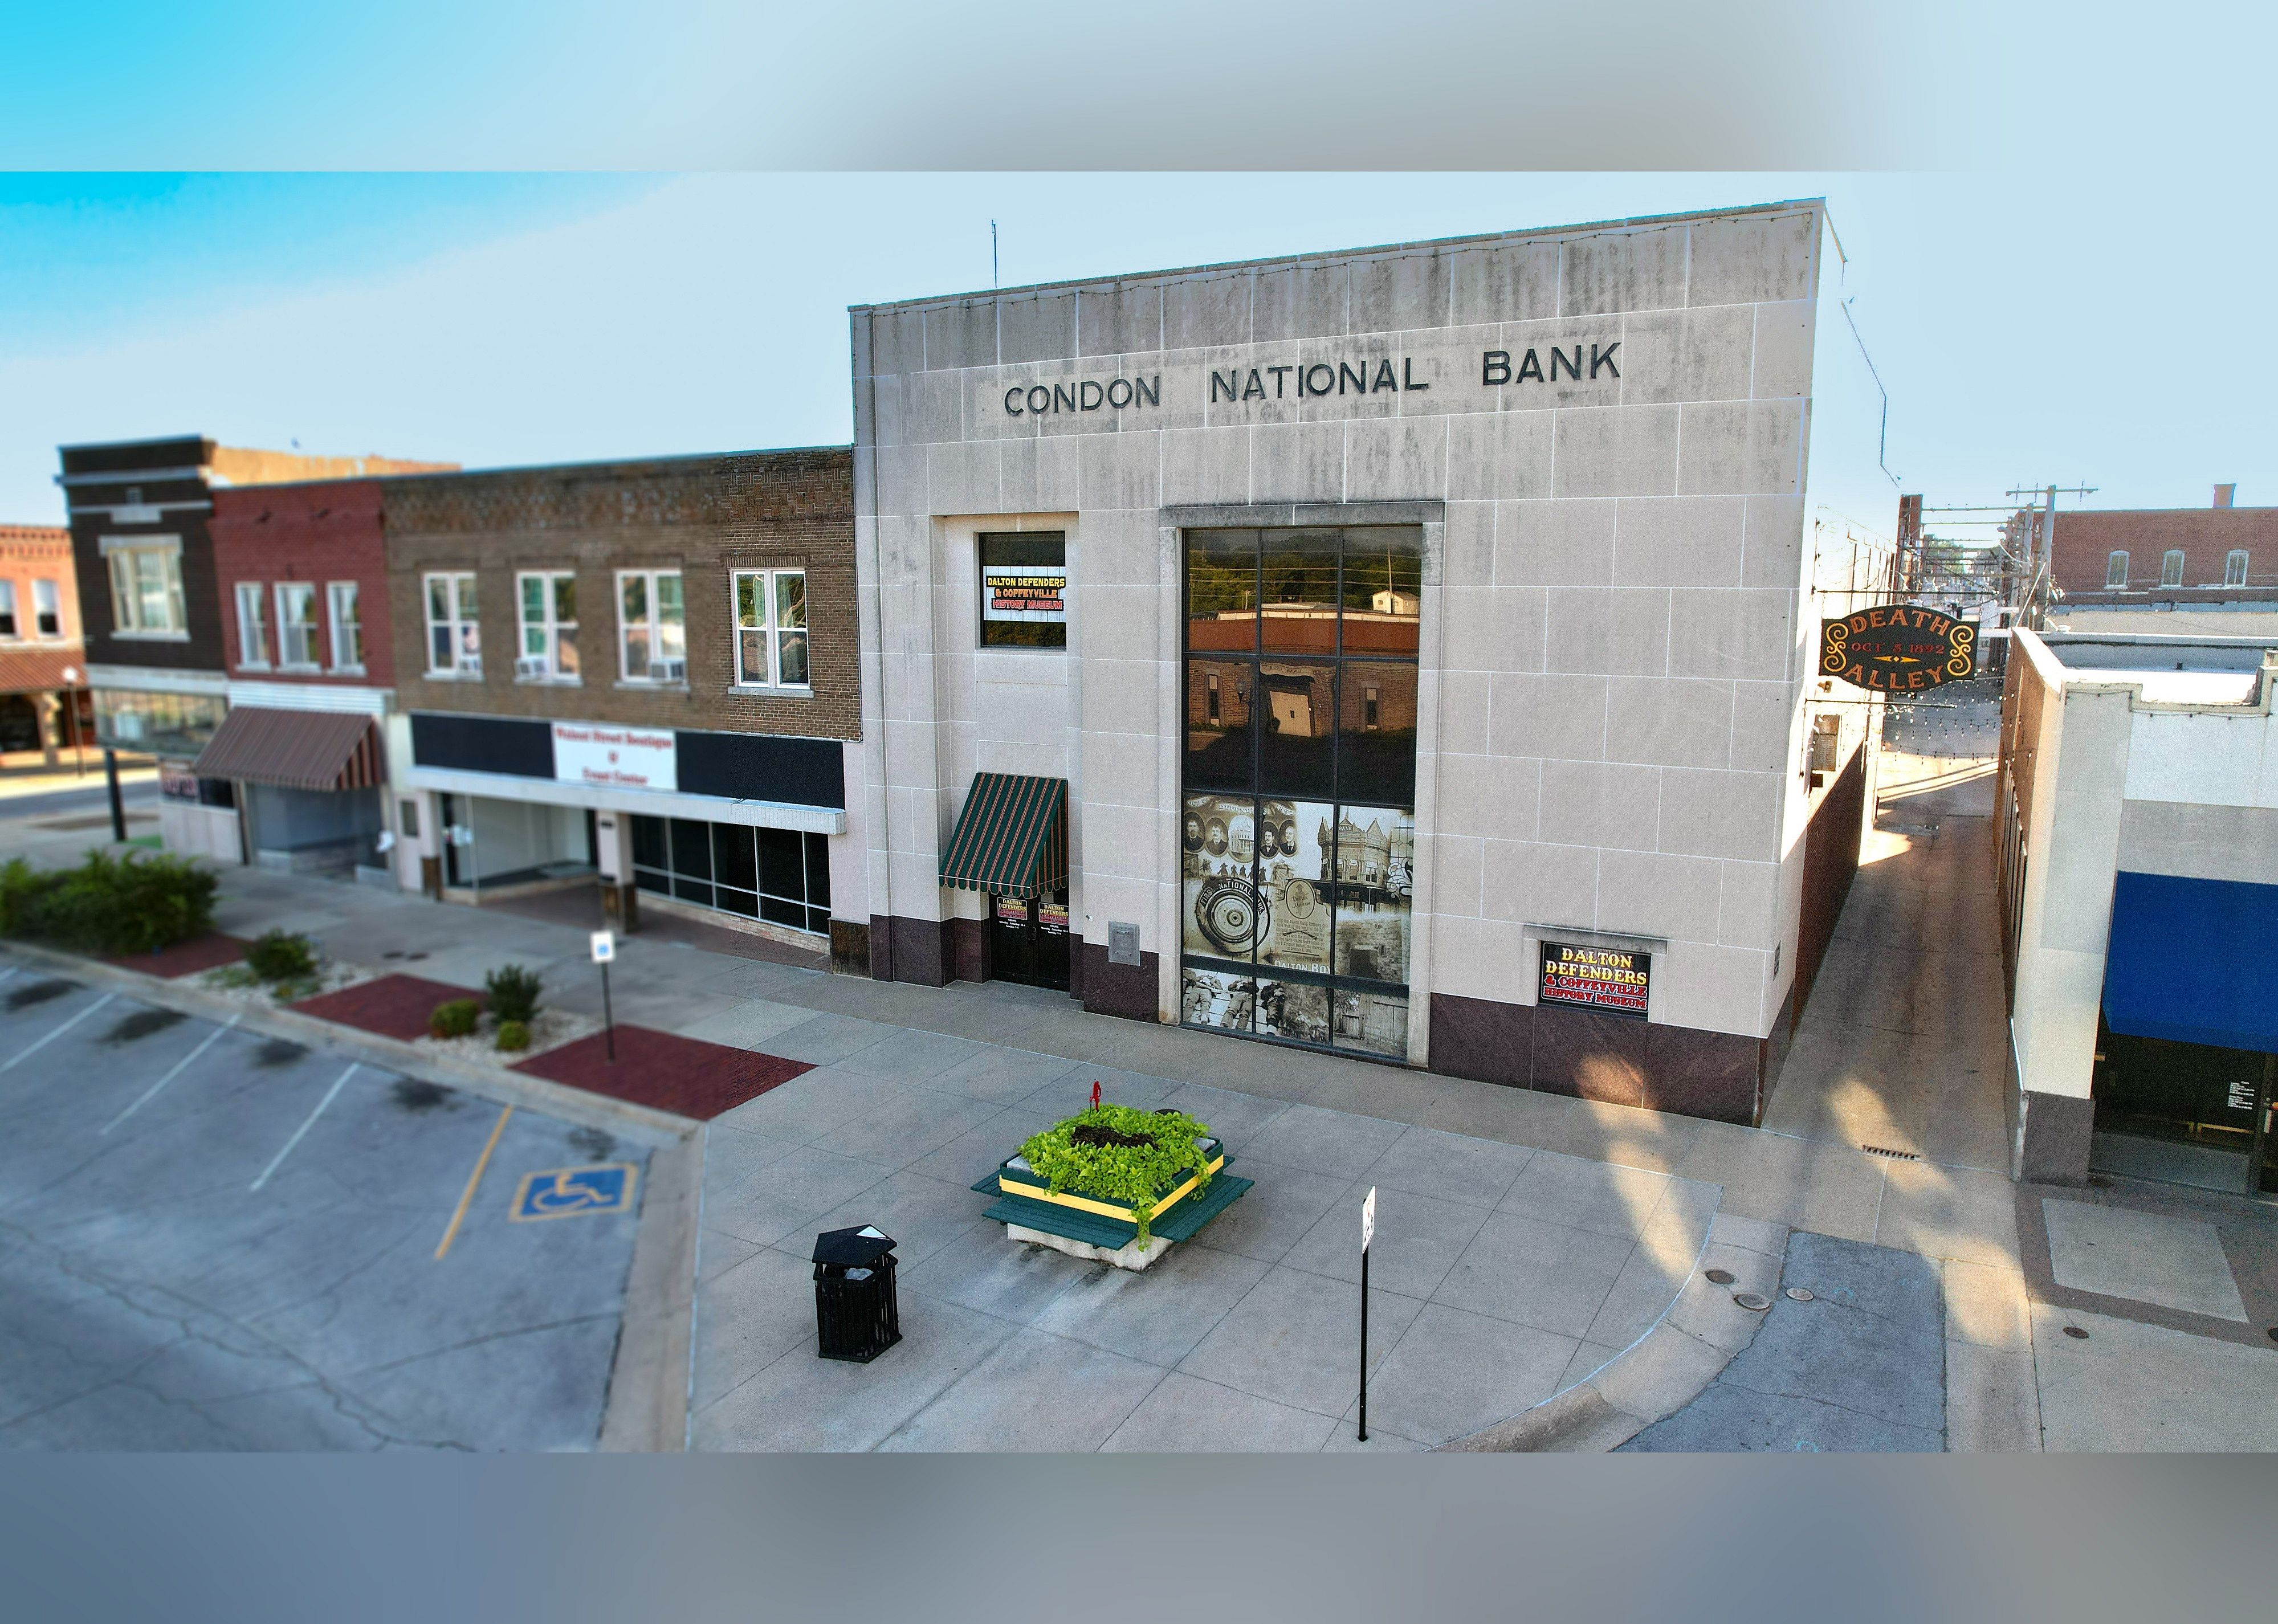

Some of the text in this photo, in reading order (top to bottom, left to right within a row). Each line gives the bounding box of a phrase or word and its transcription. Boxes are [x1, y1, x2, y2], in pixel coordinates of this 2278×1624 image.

[1005, 342, 1621, 416] CONDON NATIONAL BANK
[988, 577, 1065, 587] DALTON DEFENDERS
[995, 588, 1057, 598] & COFFEYVILLE
[992, 599, 1062, 610] HISTORY MUSEUM
[1849, 609, 1951, 636] DEATH
[1910, 643, 1945, 654] 1892
[1844, 663, 1943, 689] ALLEY
[1219, 880, 1251, 896] NATIONAL
[999, 903, 1026, 911] DEFENDERS
[1040, 908, 1069, 917] DEFENDERS
[1562, 948, 1632, 968] DALTON
[1546, 960, 1647, 985] DEFENDERS
[1544, 974, 1648, 998] & COFFEYVILLE
[1543, 986, 1647, 1010] HISTORY MUSEUM
